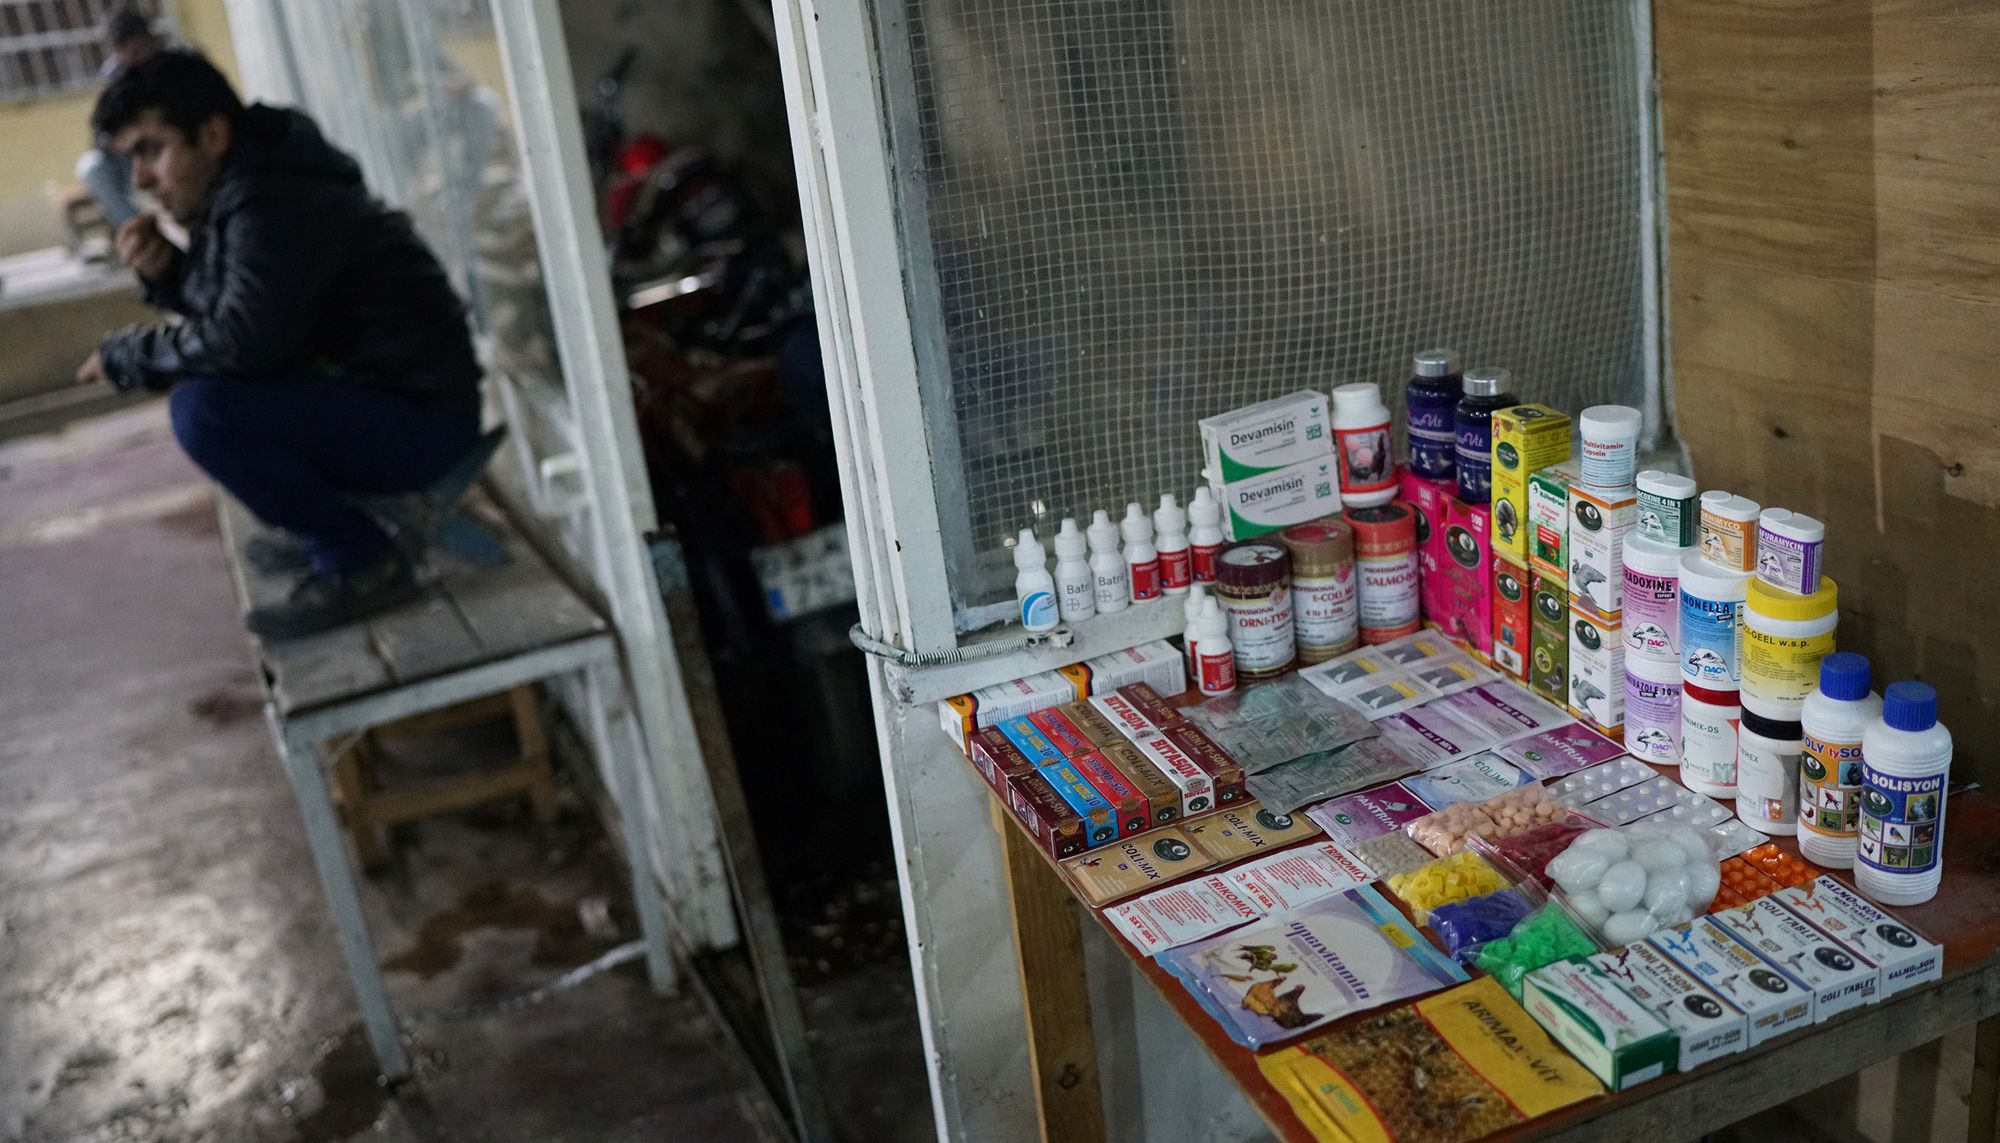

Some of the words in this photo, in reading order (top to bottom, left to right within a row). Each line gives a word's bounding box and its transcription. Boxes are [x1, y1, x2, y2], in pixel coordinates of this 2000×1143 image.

[1231, 419, 1295, 446] Devamisin
[1239, 477, 1303, 504] Devamisin
[1647, 639, 1665, 647] DAC
[1704, 665, 1722, 673] DAC
[1662, 687, 1680, 696] 10%
[1103, 695, 1150, 731] BITASON
[1150, 738, 1201, 778] BITASON
[1539, 732, 1589, 766] PANTRIM
[1652, 742, 1669, 751] DAC
[1829, 745, 1864, 758] tySO
[1871, 773, 1940, 792] SOLISYON
[1353, 793, 1399, 831] PANTRIM
[1223, 813, 1266, 848] COLI-MIX
[1121, 842, 1161, 880] COLI-MIX
[1322, 843, 1371, 883] TRIKOMIX
[1207, 876, 1257, 918] TRIKOMIX
[1245, 881, 1274, 909] SKY-USA
[1128, 915, 1158, 945] SKY-USA
[1758, 900, 1784, 920] COLI
[1782, 914, 1824, 943] TABLET
[1631, 943, 1655, 962] ORNI
[1655, 959, 1695, 992] TY-SON
[1821, 990, 1841, 1004] COLI
[1843, 977, 1876, 996] TABLET
